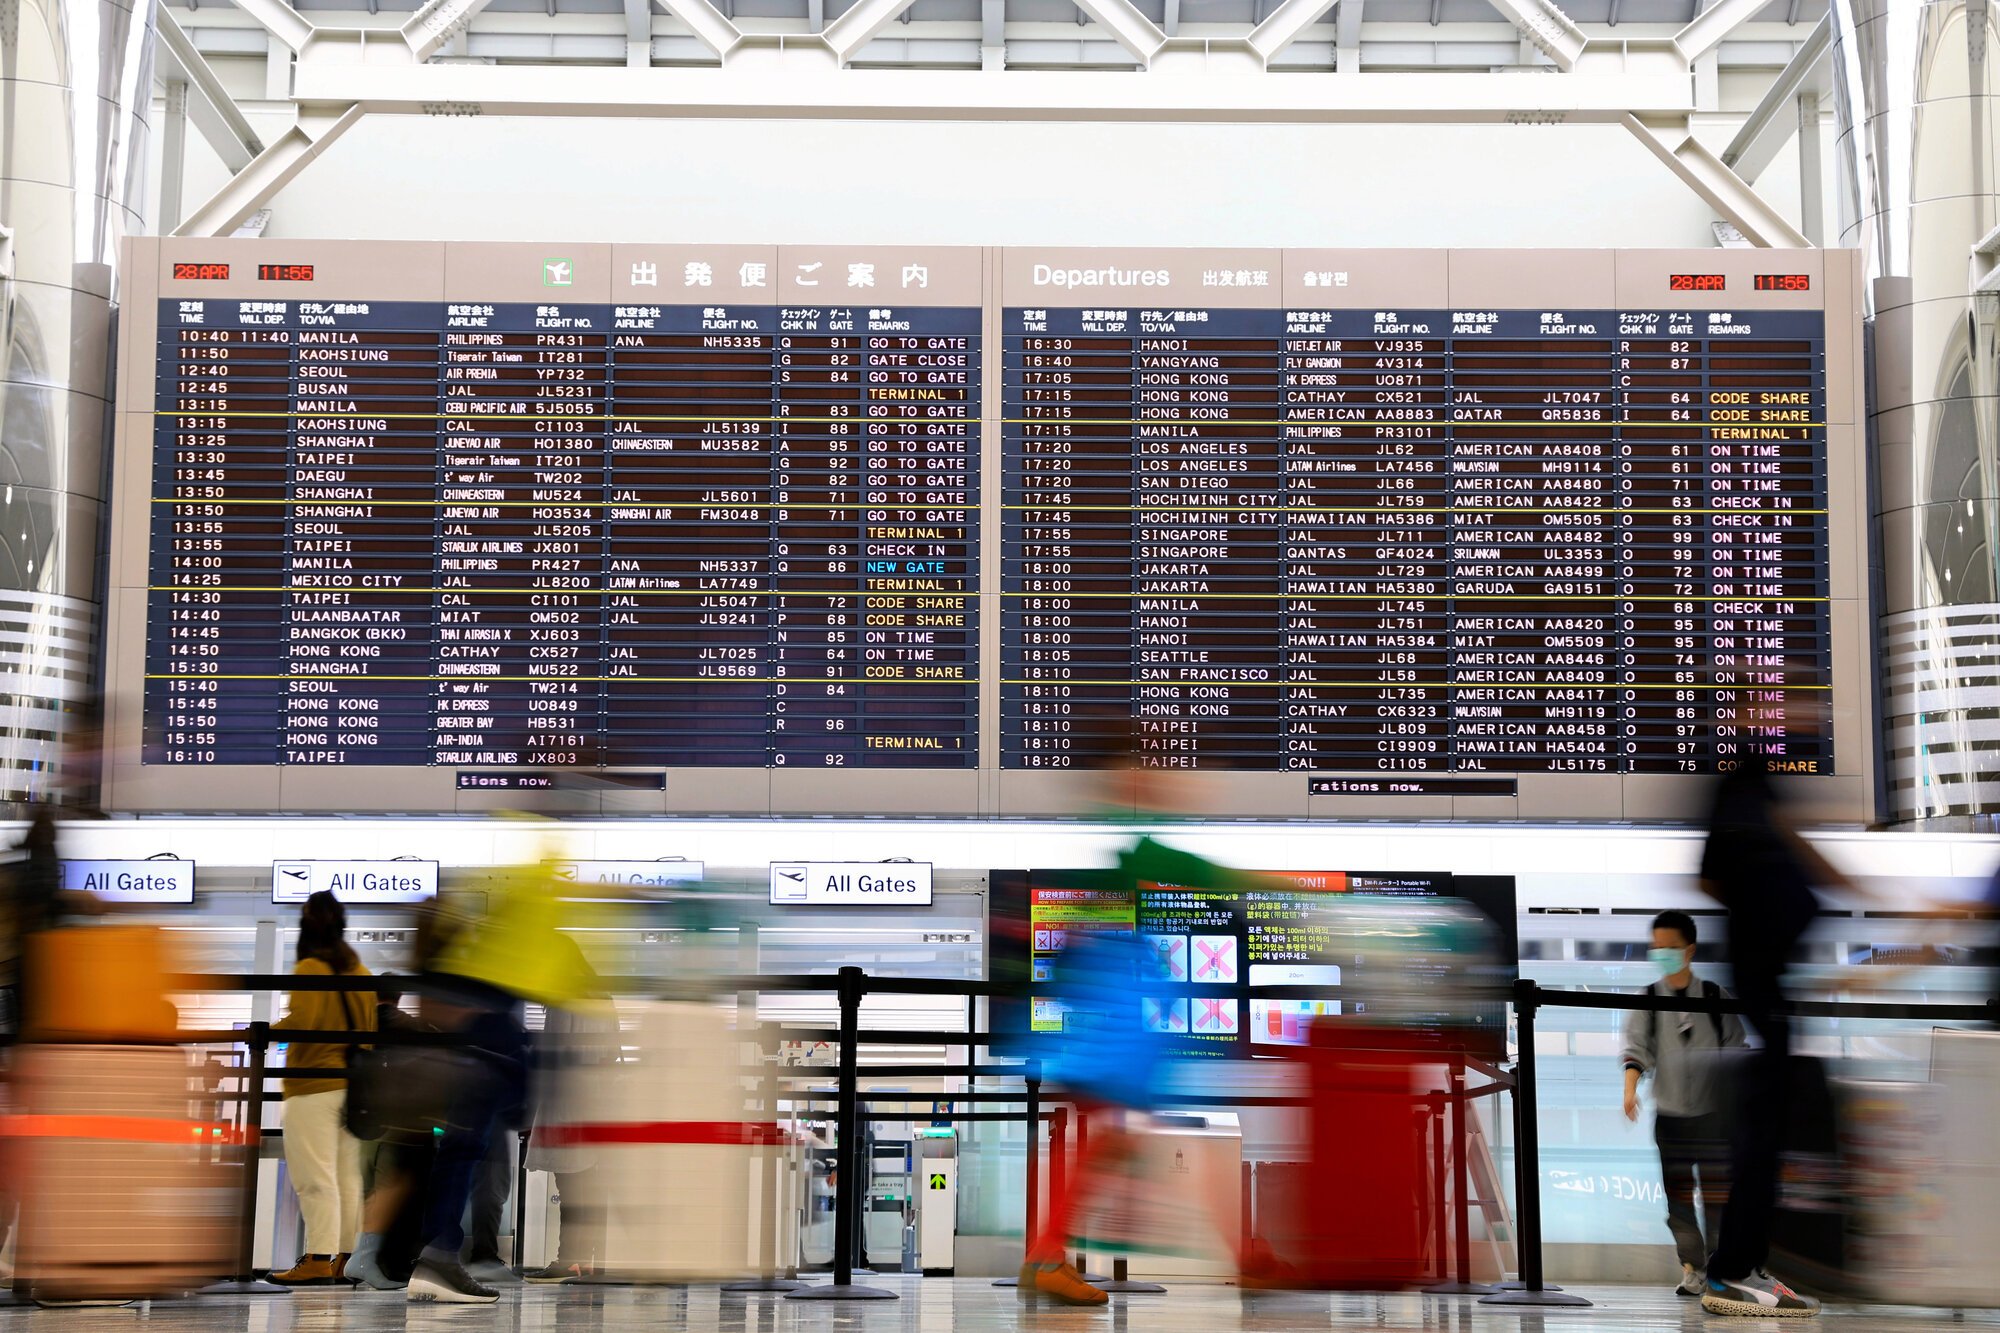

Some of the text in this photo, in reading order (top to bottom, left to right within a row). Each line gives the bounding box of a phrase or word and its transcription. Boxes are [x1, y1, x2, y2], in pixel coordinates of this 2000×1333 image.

[175, 265, 227, 279] 28 APR
[261, 266, 312, 280] 11:55
[632, 261, 927, 288] 出発便ご案内
[1034, 265, 1169, 289] Departures
[1203, 270, 1268, 286] 出发航班
[1303, 271, 1347, 286] 출발편
[1671, 276, 1723, 289] 28 APR
[1756, 276, 1809, 290] 11:55
[180, 302, 891, 319] 定刻 変更時刻 行先／経由地 航空会社 便名 航空会社 便名 チェックイン ゲート 備考
[1024, 310, 1732, 323] 定刻 変更時刻 行先／経由地 航空会社 便名 航空会社 便名 チェックイン ゲート 備考
[179, 314, 909, 330] TIME WILL DEP. TO/VIA AIRLINE FLIGHT NO. AIRLINE FLIGHT NO. CHK IN GATE REMARKS
[1024, 322, 1751, 334] TIME WILL DEP. TO/VIA AIRLINE FLIGHT NO. AIRLINE FLIGHT NO. CHK IN GATE REMARKS
[182, 331, 965, 349] 10:40 11:40 MANILA PHILIPPINES PR431 ANA NH5335 Q 91 GO TO GATE
[1026, 512, 1791, 526] 17:45 HOCHIMINH CITY HAWAIIAN HA5386 MIAT OM5505 O 63 CHECK IN
[172, 628, 934, 642] 14:45 BANGKOK (BKK) THAI AIRASIA X XJ603 N 85 ON TIME
[167, 751, 843, 765] 16:10 TAIPEI STARLUX AIRLINES JX803 Q 92
[1024, 756, 1069, 766] 18:20
[1142, 757, 1196, 767] TAIPEI
[1289, 758, 1317, 768] CAL
[1379, 759, 1426, 769] CI105
[1459, 759, 1486, 769] JAL
[1548, 760, 1605, 770] JL5175
[1630, 760, 1634, 770] I
[1679, 761, 1695, 770] 75
[1766, 760, 1818, 772] SHARE
[461, 776, 552, 786] tions now.
[1312, 782, 1424, 792] rations now.
[84, 873, 176, 890] All Gates
[330, 873, 421, 891] All Gates
[598, 872, 625, 886] All
[826, 876, 915, 892] All Gates
[1272, 952, 1309, 960] 넣어주세요.
